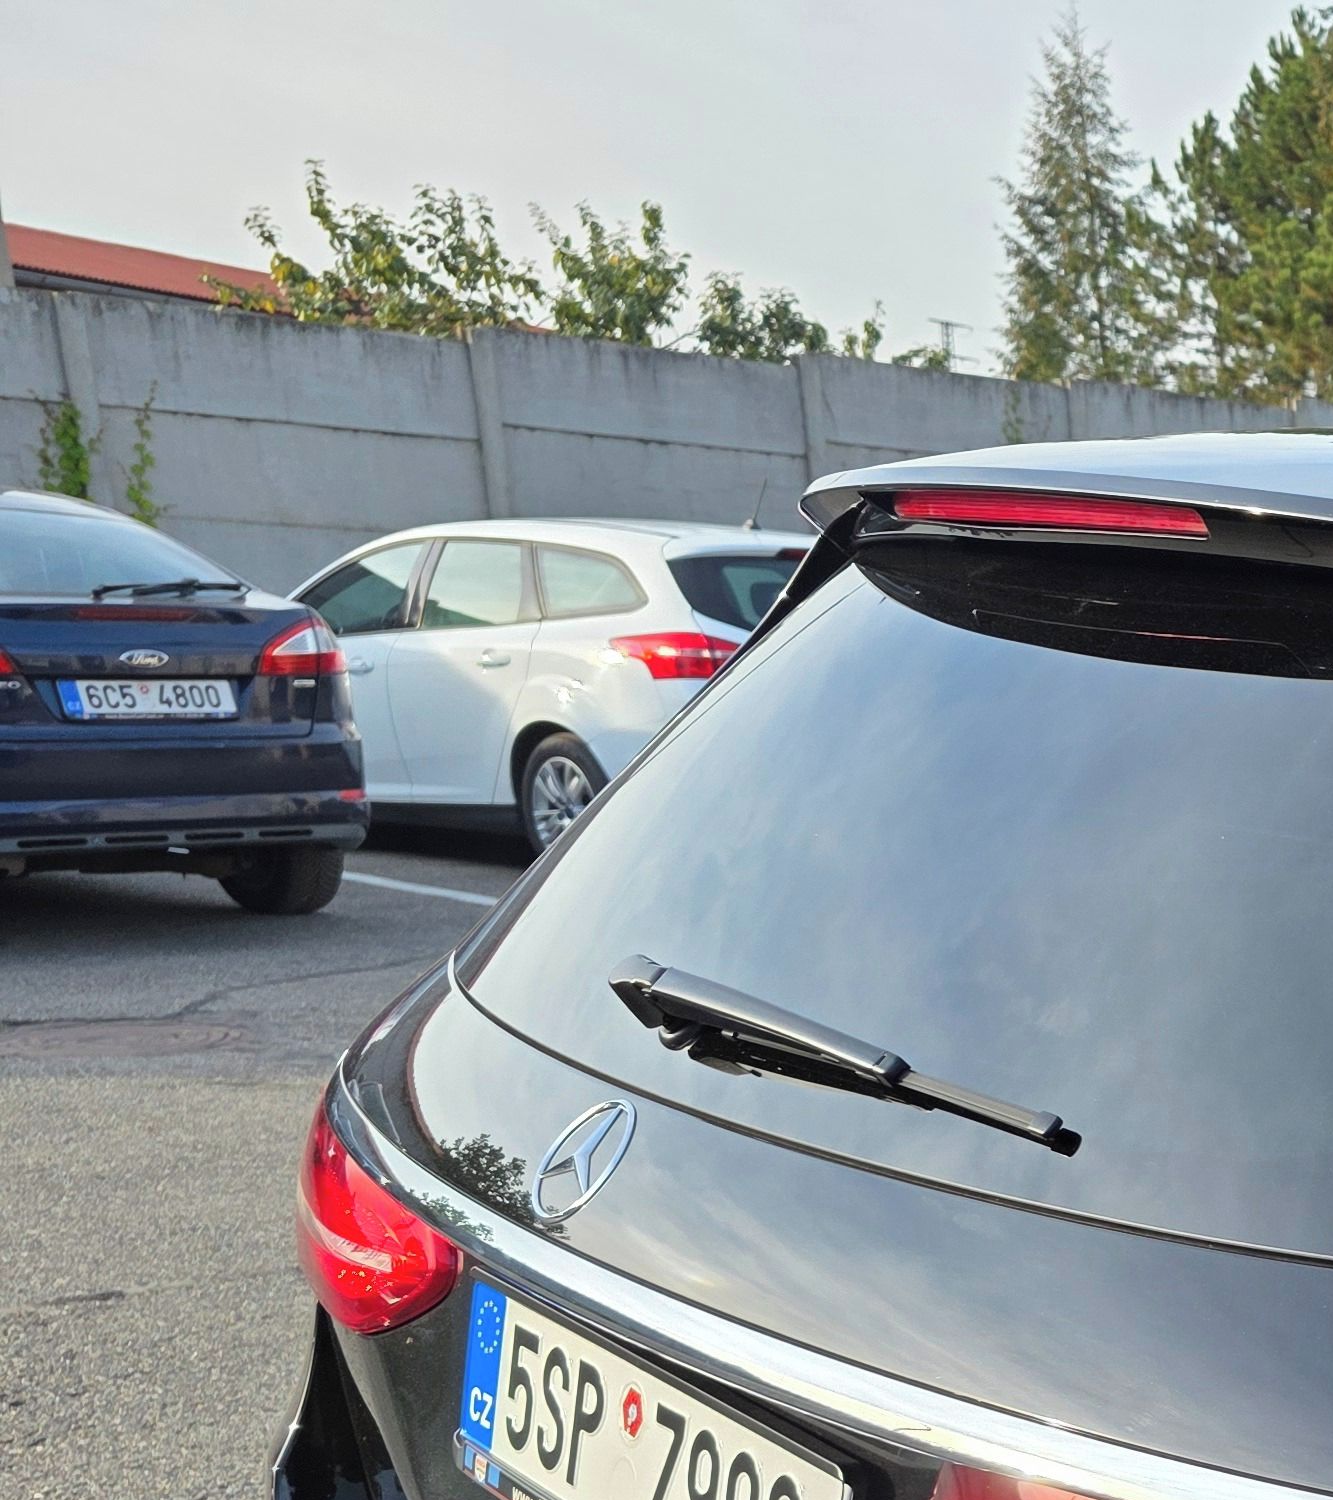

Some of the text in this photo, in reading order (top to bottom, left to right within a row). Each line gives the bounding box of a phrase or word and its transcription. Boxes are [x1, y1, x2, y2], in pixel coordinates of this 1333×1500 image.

[85, 684, 221, 709] 6C5 4800
[470, 1386, 493, 1429] CZ
[506, 1324, 604, 1486] 5SP
